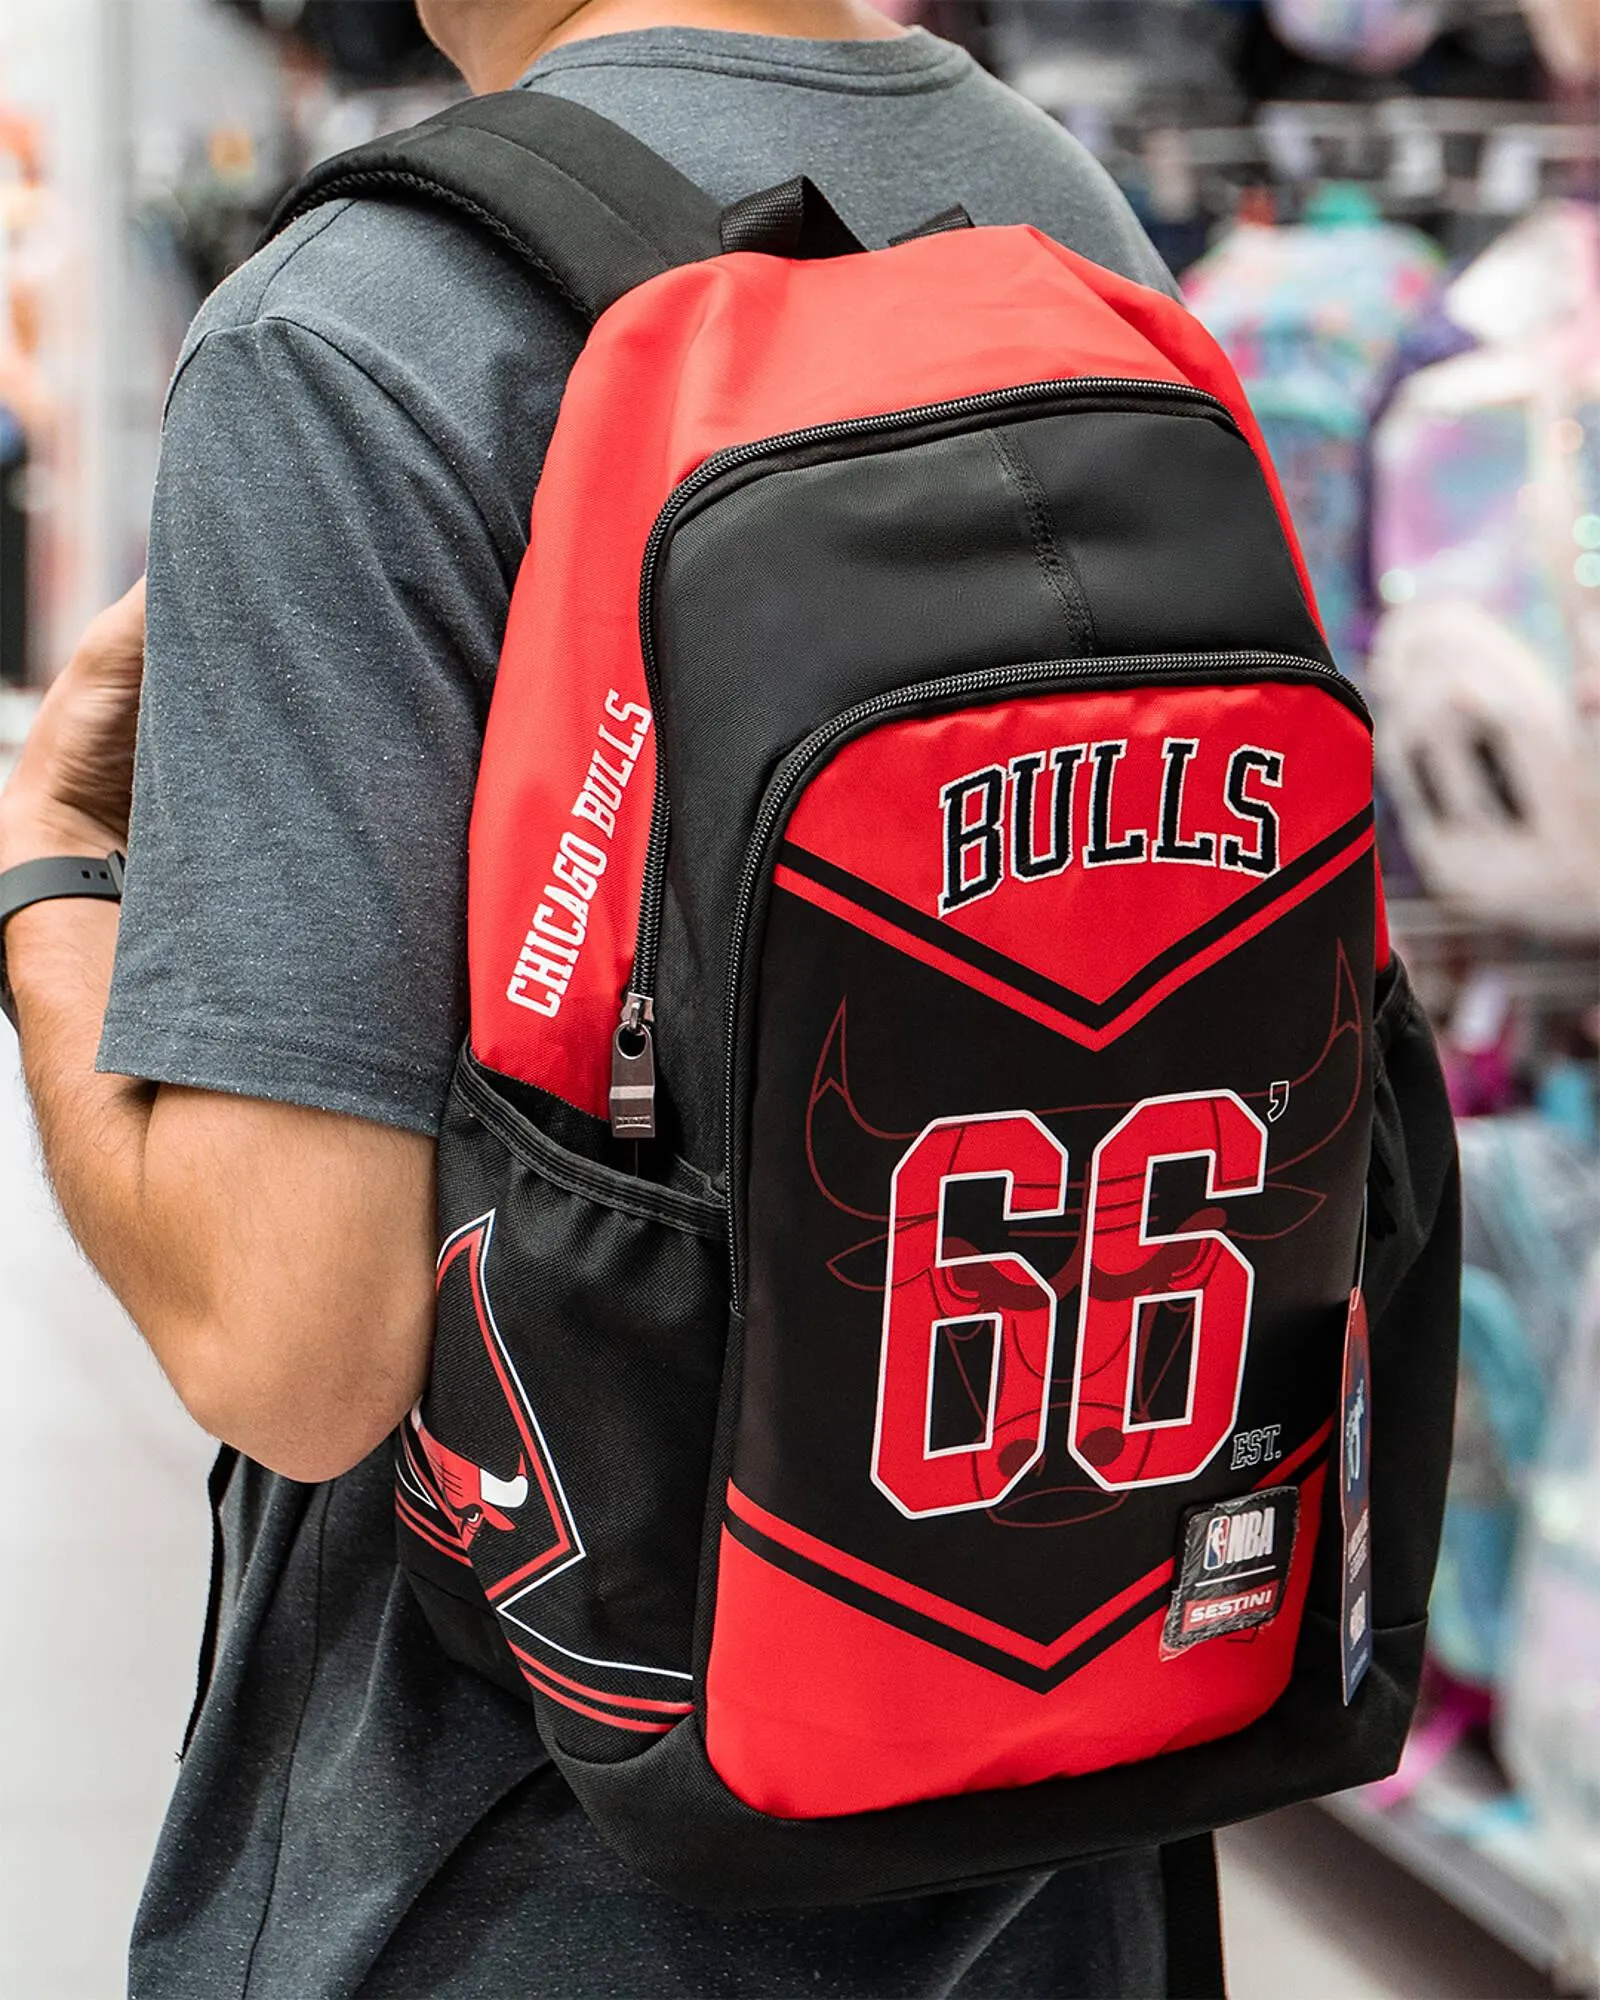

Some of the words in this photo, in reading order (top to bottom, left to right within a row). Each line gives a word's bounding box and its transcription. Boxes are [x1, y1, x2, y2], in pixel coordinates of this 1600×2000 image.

[506, 831, 608, 1018] CHICAGO
[571, 687, 653, 840] BULLS
[938, 736, 1285, 918] BULLS
[1230, 1424, 1283, 1470] EST.
[1227, 1506, 1276, 1564] NBA
[1190, 1589, 1273, 1624] SESTINI
